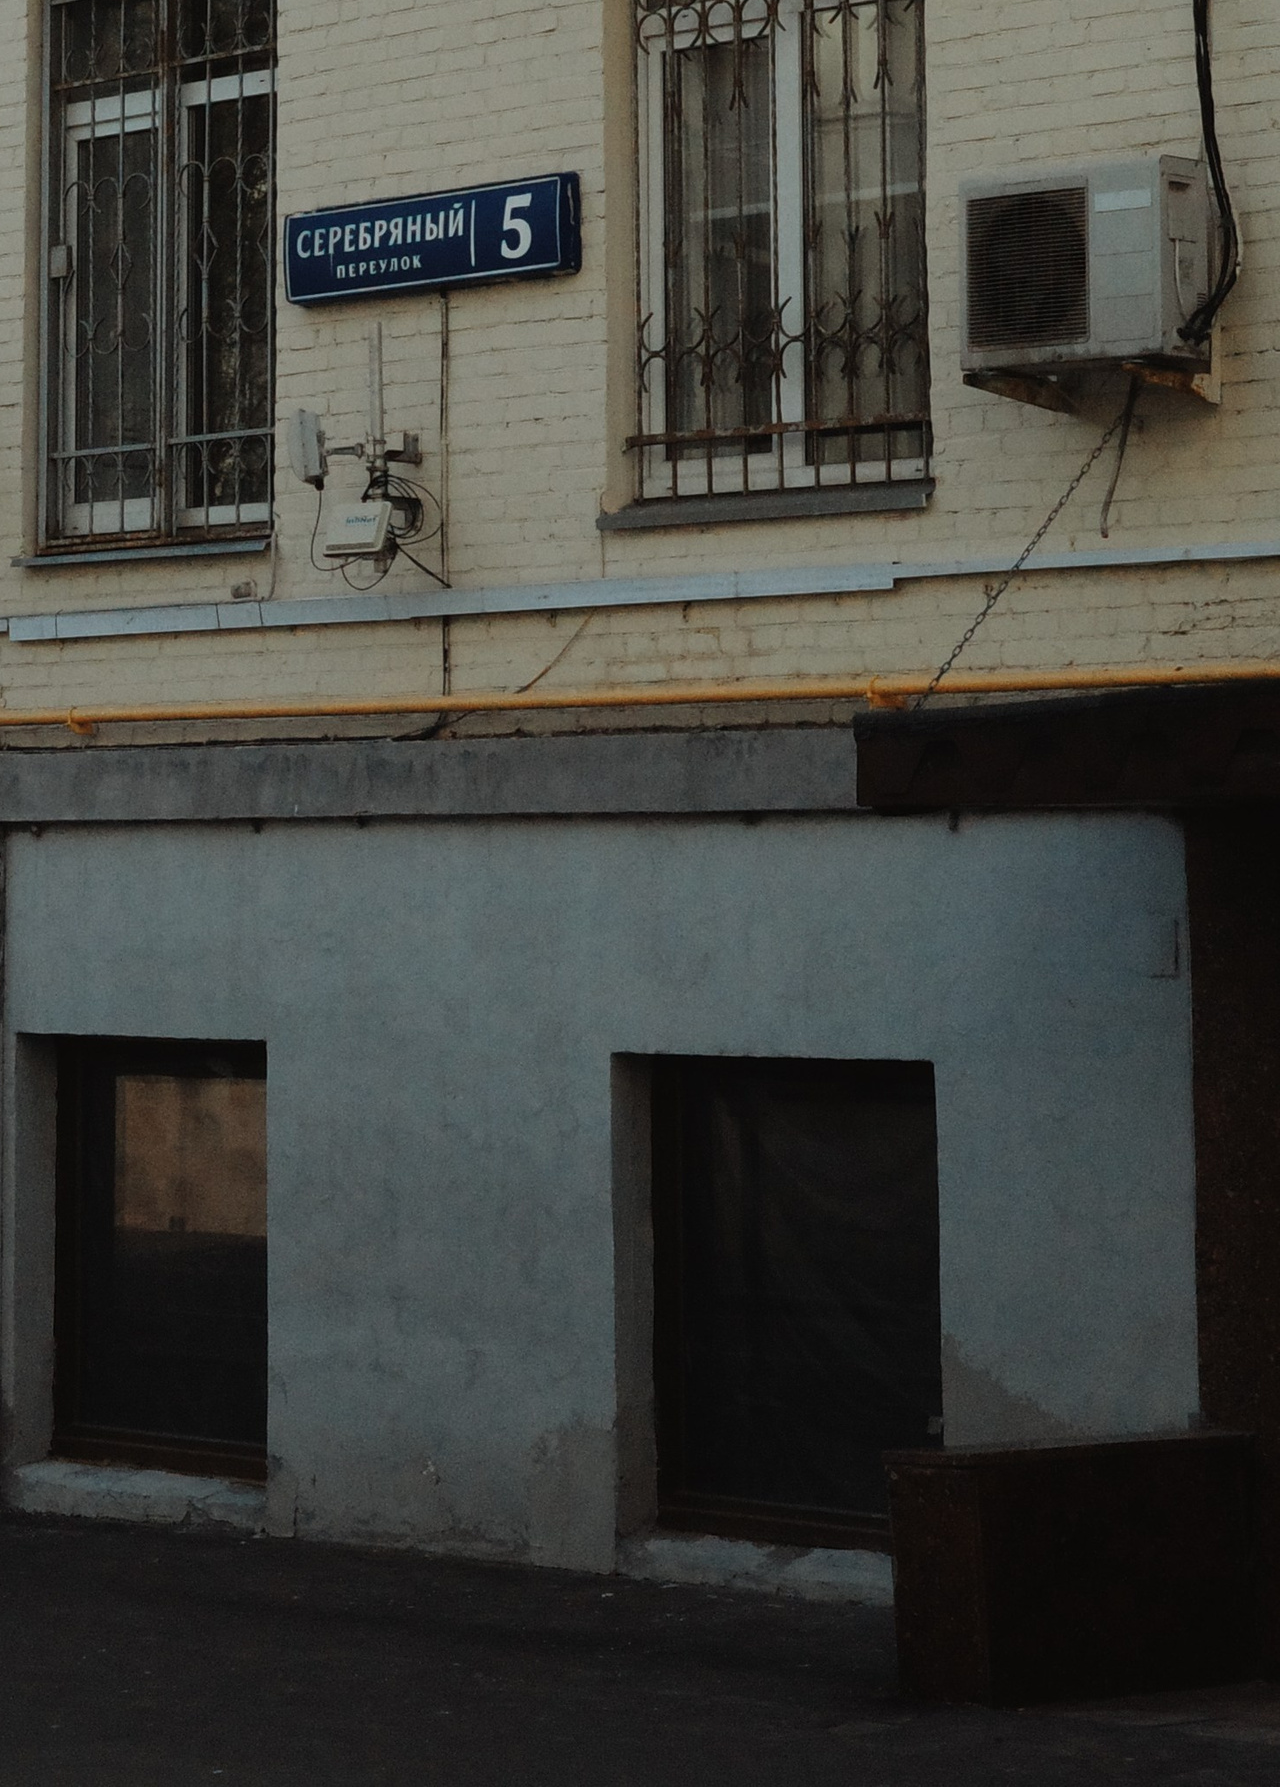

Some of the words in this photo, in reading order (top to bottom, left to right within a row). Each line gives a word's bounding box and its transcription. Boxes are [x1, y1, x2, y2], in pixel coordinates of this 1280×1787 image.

[296, 202, 464, 258] СЕРЕБРЯНЫЙ
[500, 192, 532, 259] 5
[336, 254, 422, 279] ПЕРЕУЛОК
